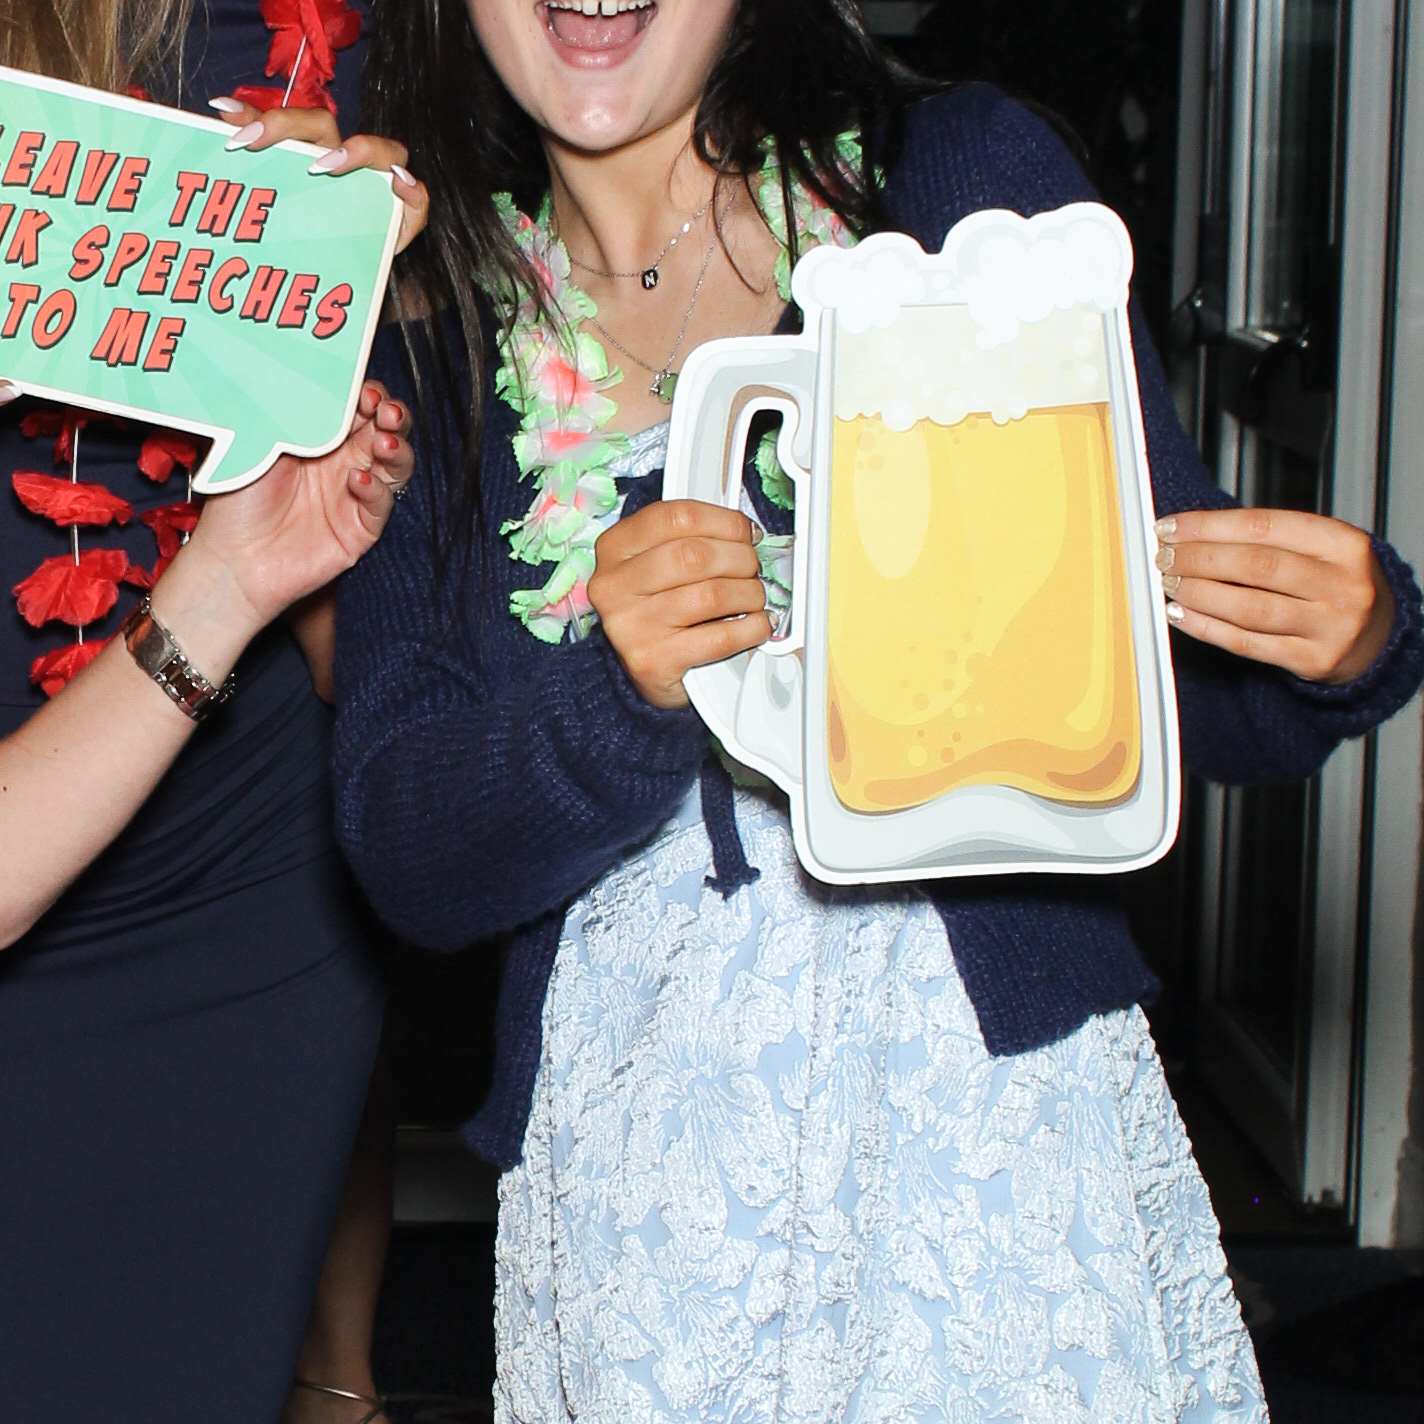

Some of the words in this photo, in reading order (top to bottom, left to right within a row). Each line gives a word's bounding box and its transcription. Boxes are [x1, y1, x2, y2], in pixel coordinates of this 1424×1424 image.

[169, 172, 276, 243] THE
[68, 224, 353, 339] SPEECHES
[0, 282, 76, 349] TO
[90, 308, 185, 372] ME
